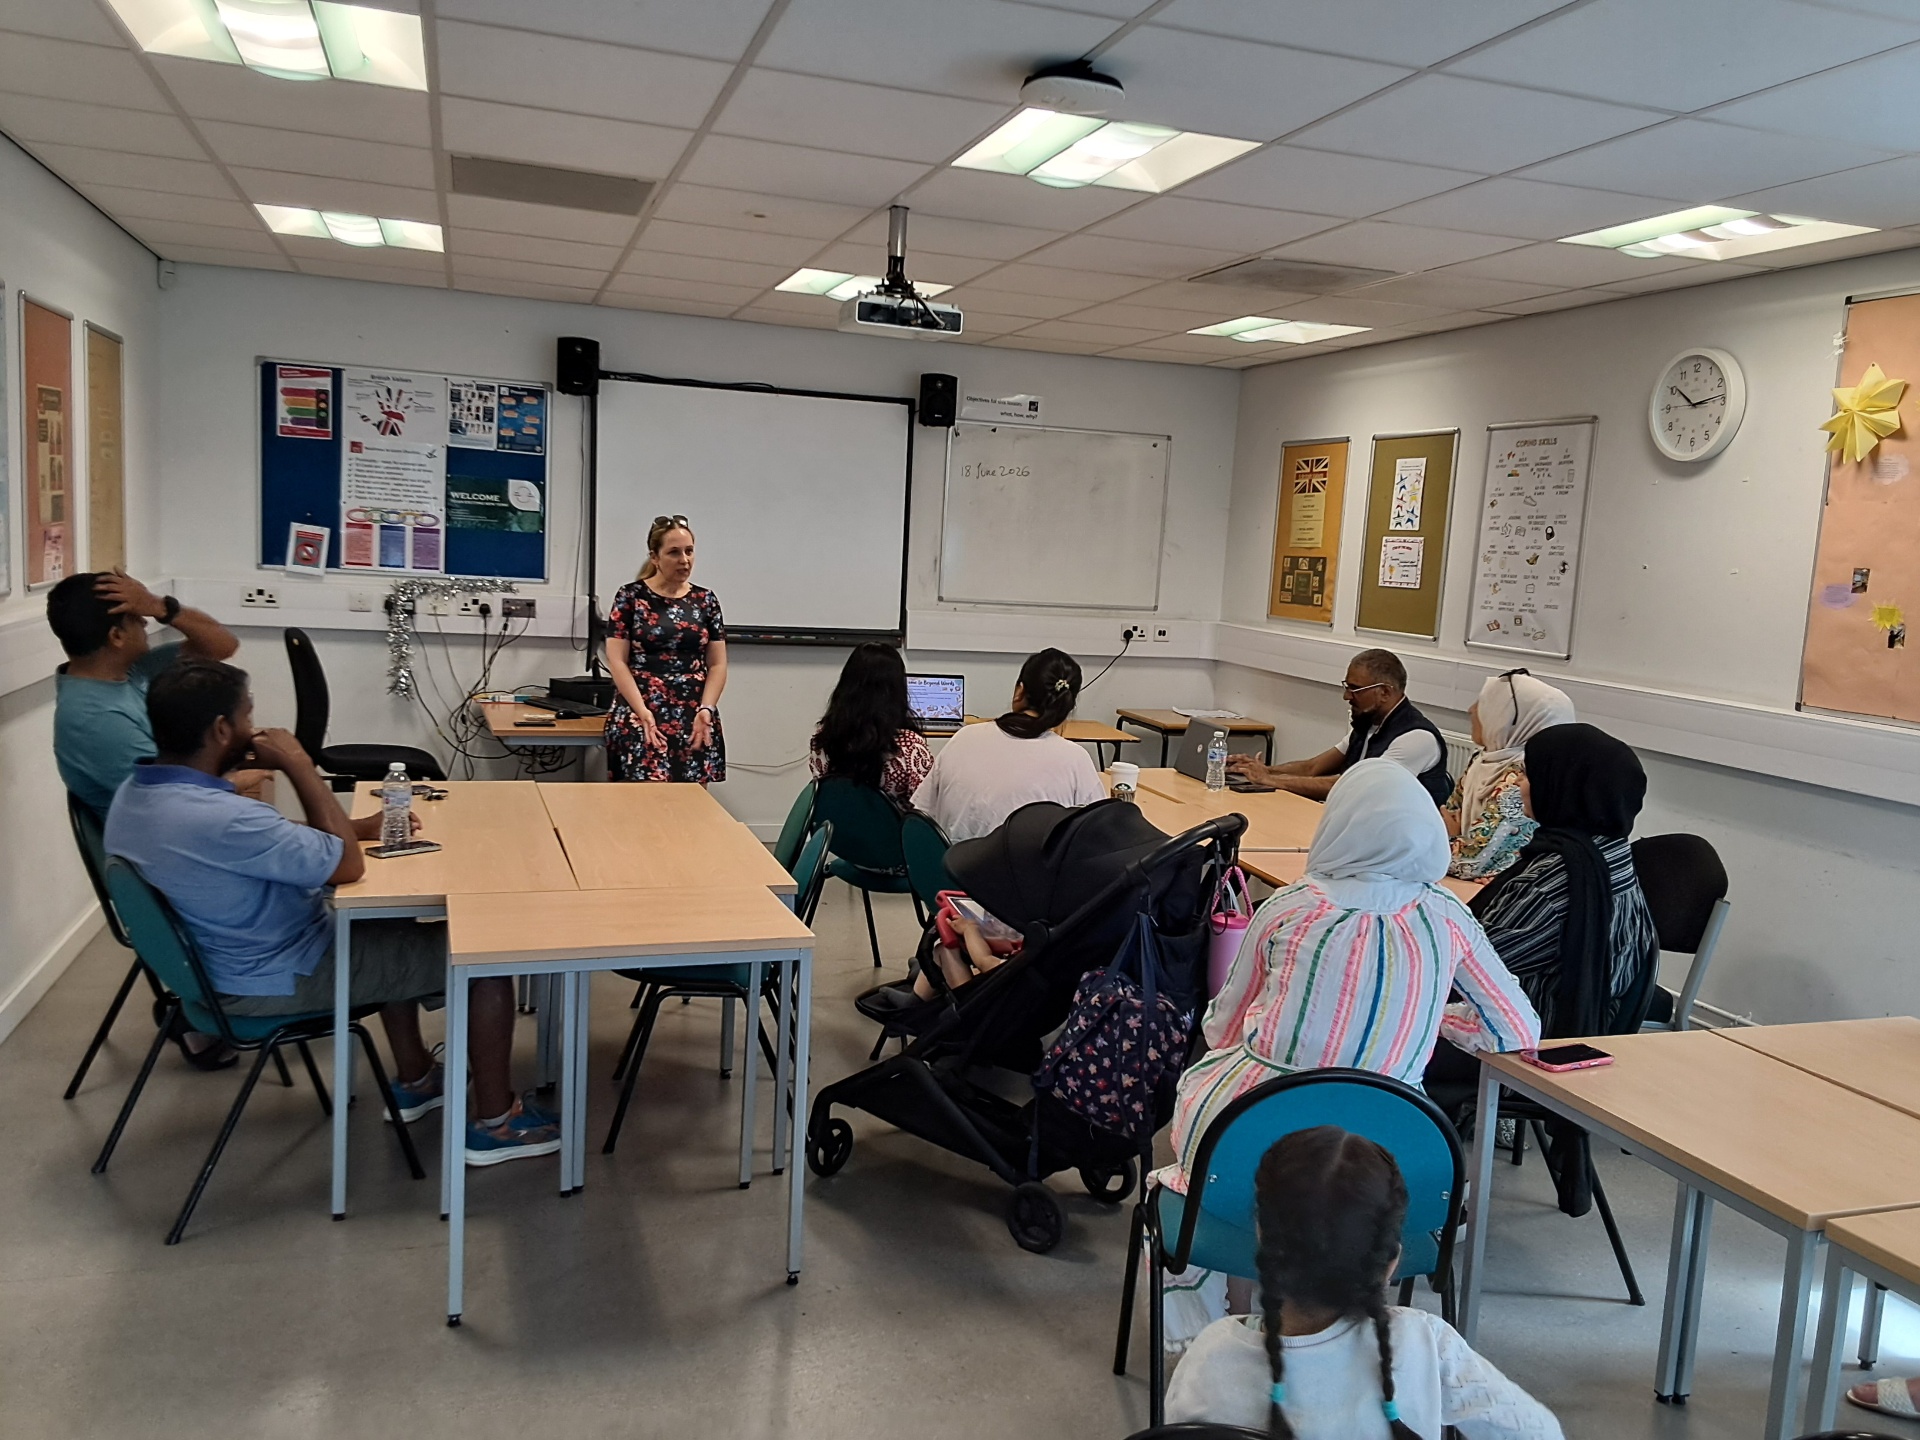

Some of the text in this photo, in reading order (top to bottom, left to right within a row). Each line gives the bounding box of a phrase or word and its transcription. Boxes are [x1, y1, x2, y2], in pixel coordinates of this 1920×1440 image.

[1693, 363, 1701, 373] 12
[1709, 366, 1713, 376] 1
[1680, 371, 1687, 380] 11
[1717, 377, 1723, 388] 2
[1670, 386, 1677, 396] 10
[1720, 396, 1726, 406] 3
[1665, 404, 1671, 414] 9
[1715, 416, 1721, 426] 4
[1667, 422, 1673, 431] 8
[1676, 434, 1682, 444] 7
[1704, 431, 1710, 441] 5
[1516, 439, 1537, 448] COPING
[1689, 437, 1695, 447] 6
[961, 462, 1030, 479] 18 June 2026
[450, 491, 500, 502] WELCOME
